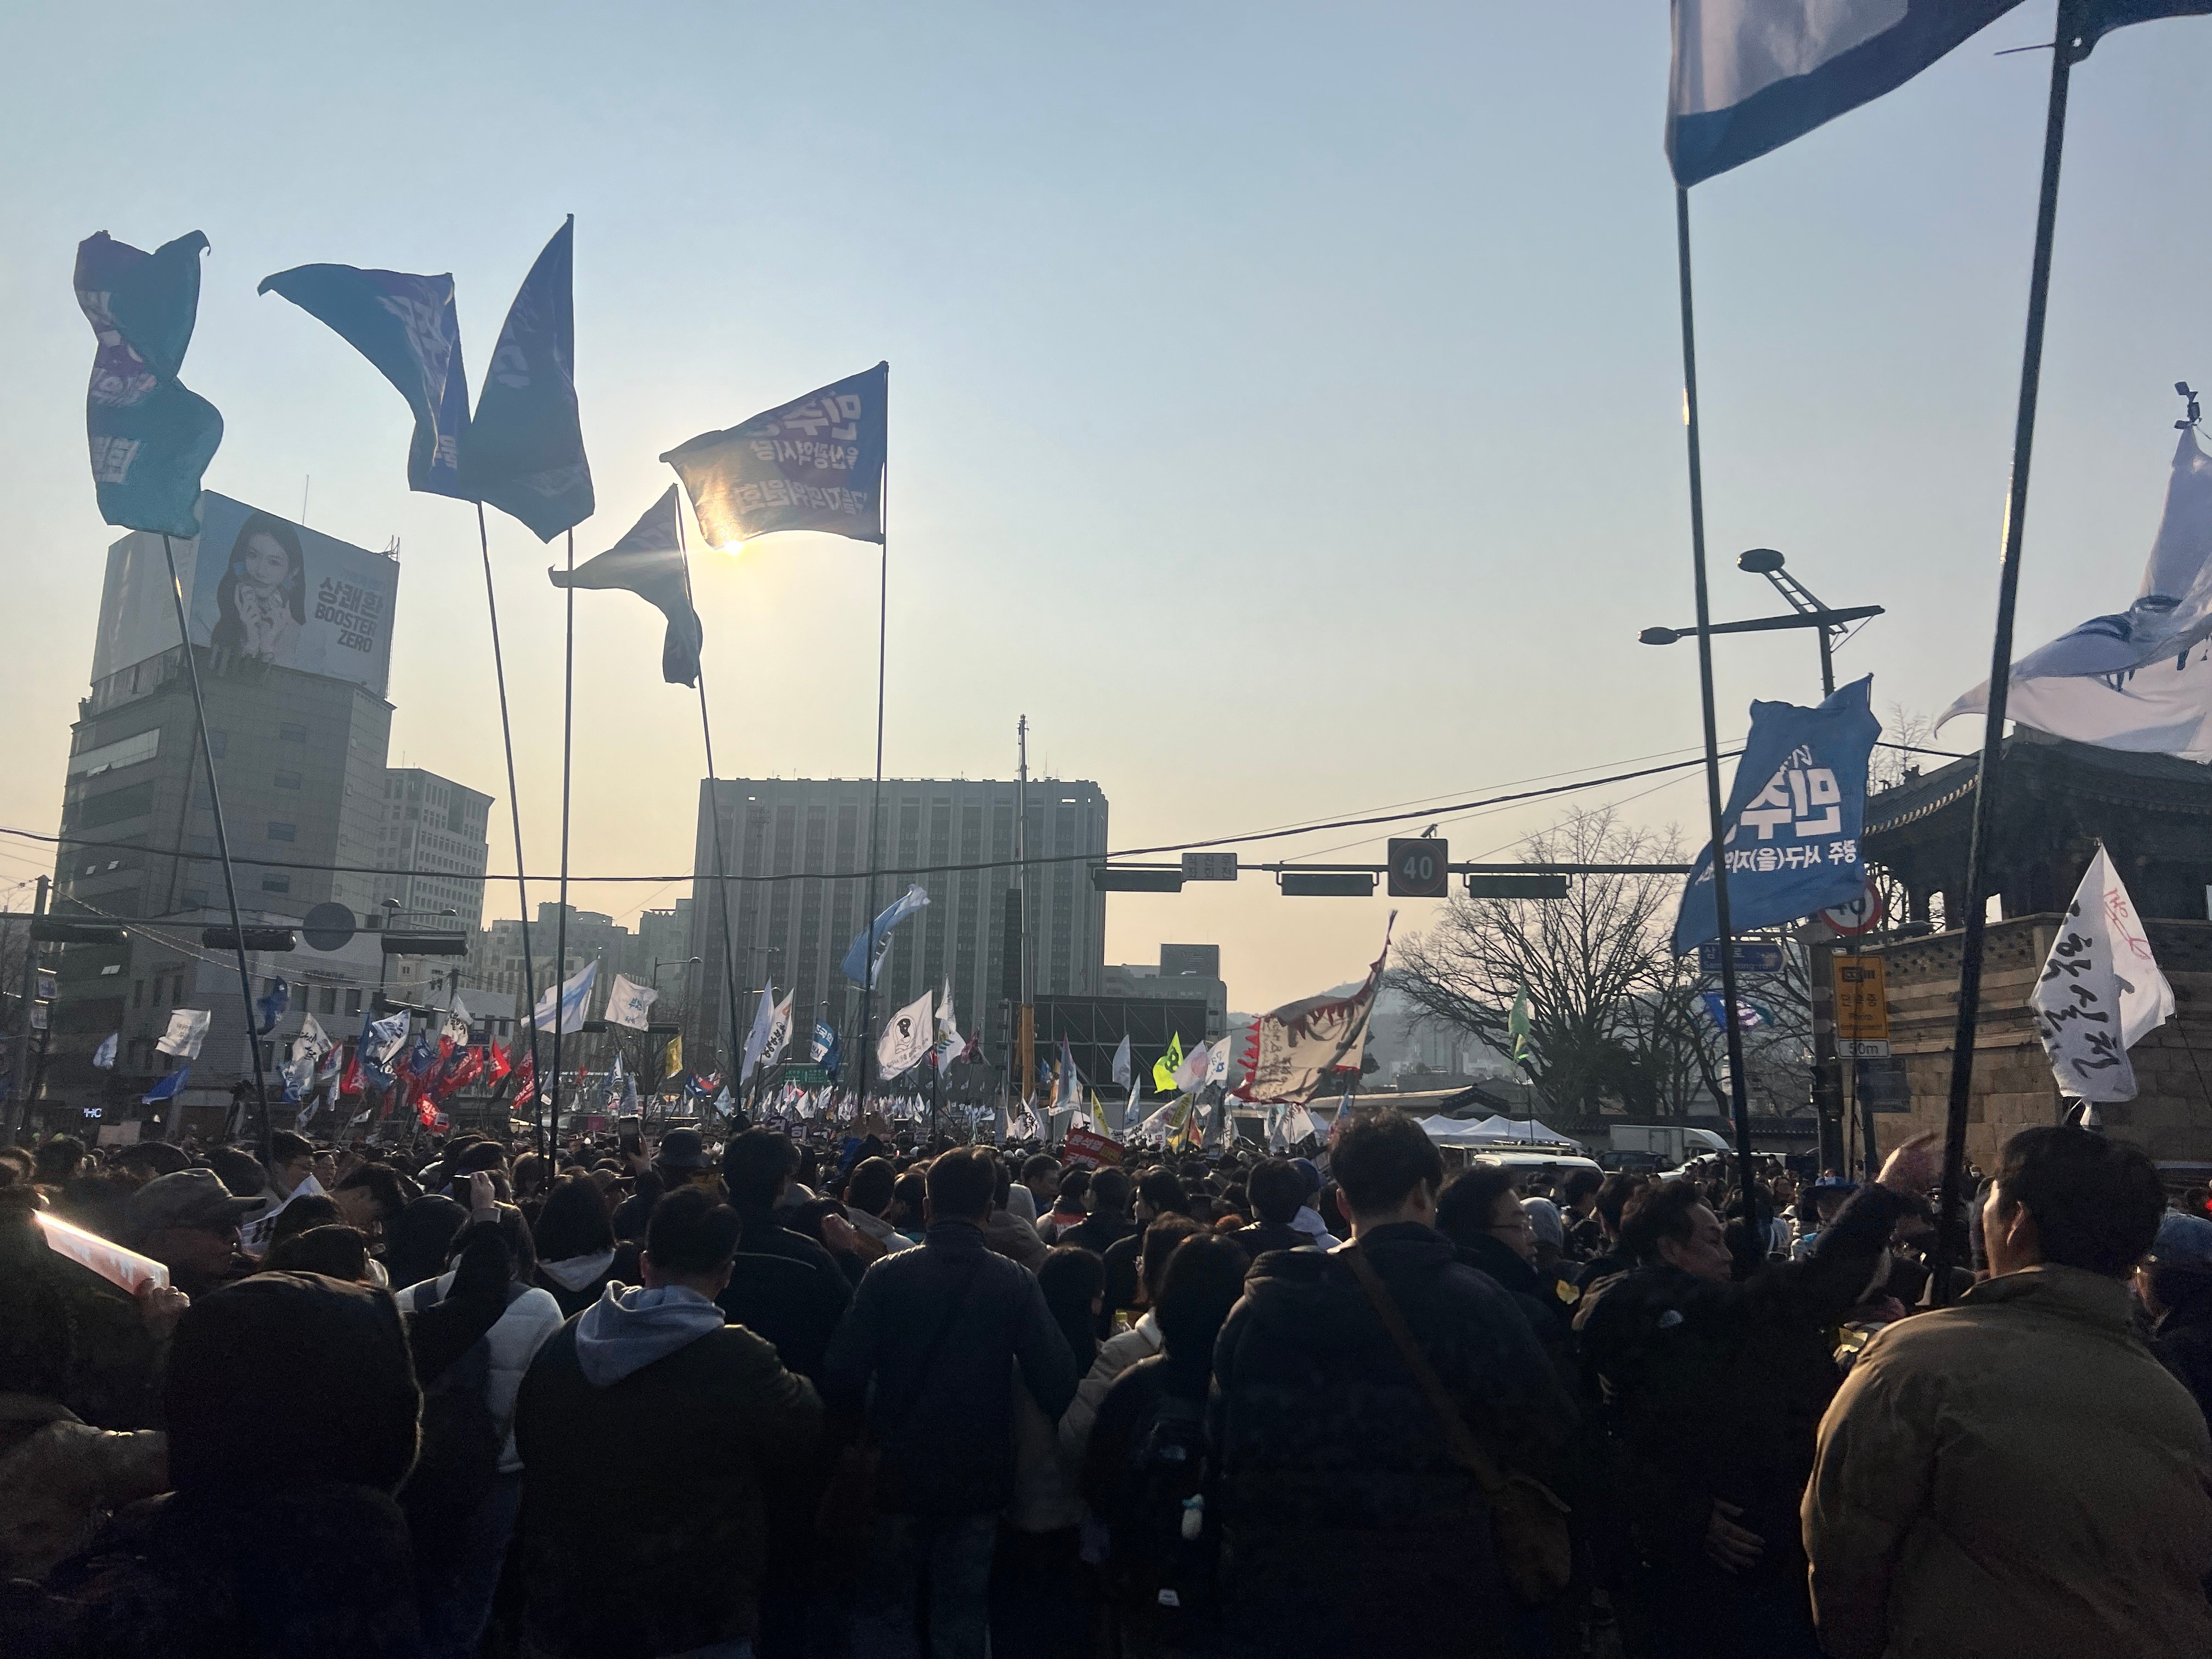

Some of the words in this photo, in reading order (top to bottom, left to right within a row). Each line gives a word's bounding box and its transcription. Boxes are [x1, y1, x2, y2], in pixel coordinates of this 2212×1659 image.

[318, 577, 383, 620] 상쾌환
[315, 602, 377, 637] BOOSTER
[337, 629, 373, 653] ZERO
[1187, 855, 1231, 866] 직진후
[1403, 856, 1432, 879] 40
[1187, 867, 1231, 878] 좌회전
[1703, 946, 1745, 960] 삼로
[1704, 961, 1769, 972] Sameong-ro
[1069, 1134, 1104, 1151] 윤석열
